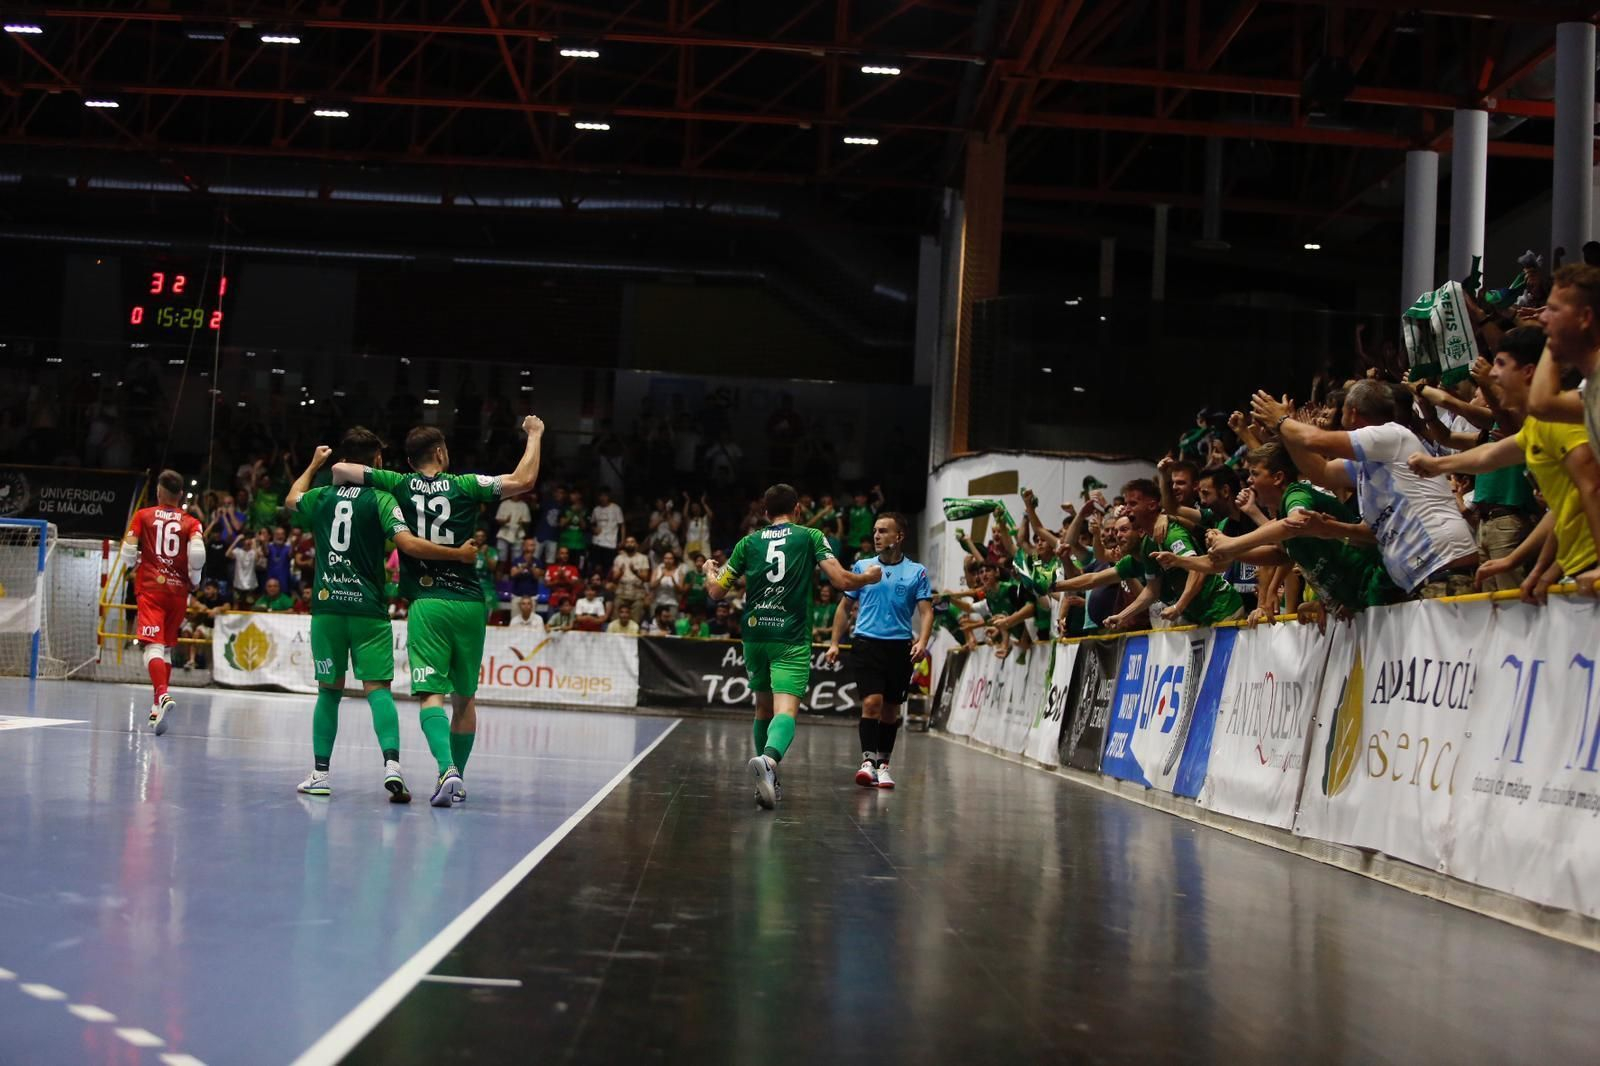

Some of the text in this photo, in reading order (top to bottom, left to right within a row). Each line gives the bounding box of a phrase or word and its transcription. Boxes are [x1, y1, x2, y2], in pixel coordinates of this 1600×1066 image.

[150, 272, 164, 294] 3
[173, 275, 185, 293] 2
[219, 277, 227, 296] 1
[130, 306, 144, 325] 0
[157, 307, 204, 328] 15:29
[209, 310, 223, 329] 2
[40, 487, 116, 503] UNIVERSIDAD
[39, 500, 103, 515] DE MÁLAGA
[154, 509, 181, 521] CONEJO
[330, 500, 353, 552] 8
[410, 494, 454, 545] 12
[153, 520, 181, 557] 16
[761, 527, 792, 540] MIGUEL
[765, 538, 786, 583] 5
[556, 673, 612, 697] viajes
[702, 674, 857, 711] TOES
